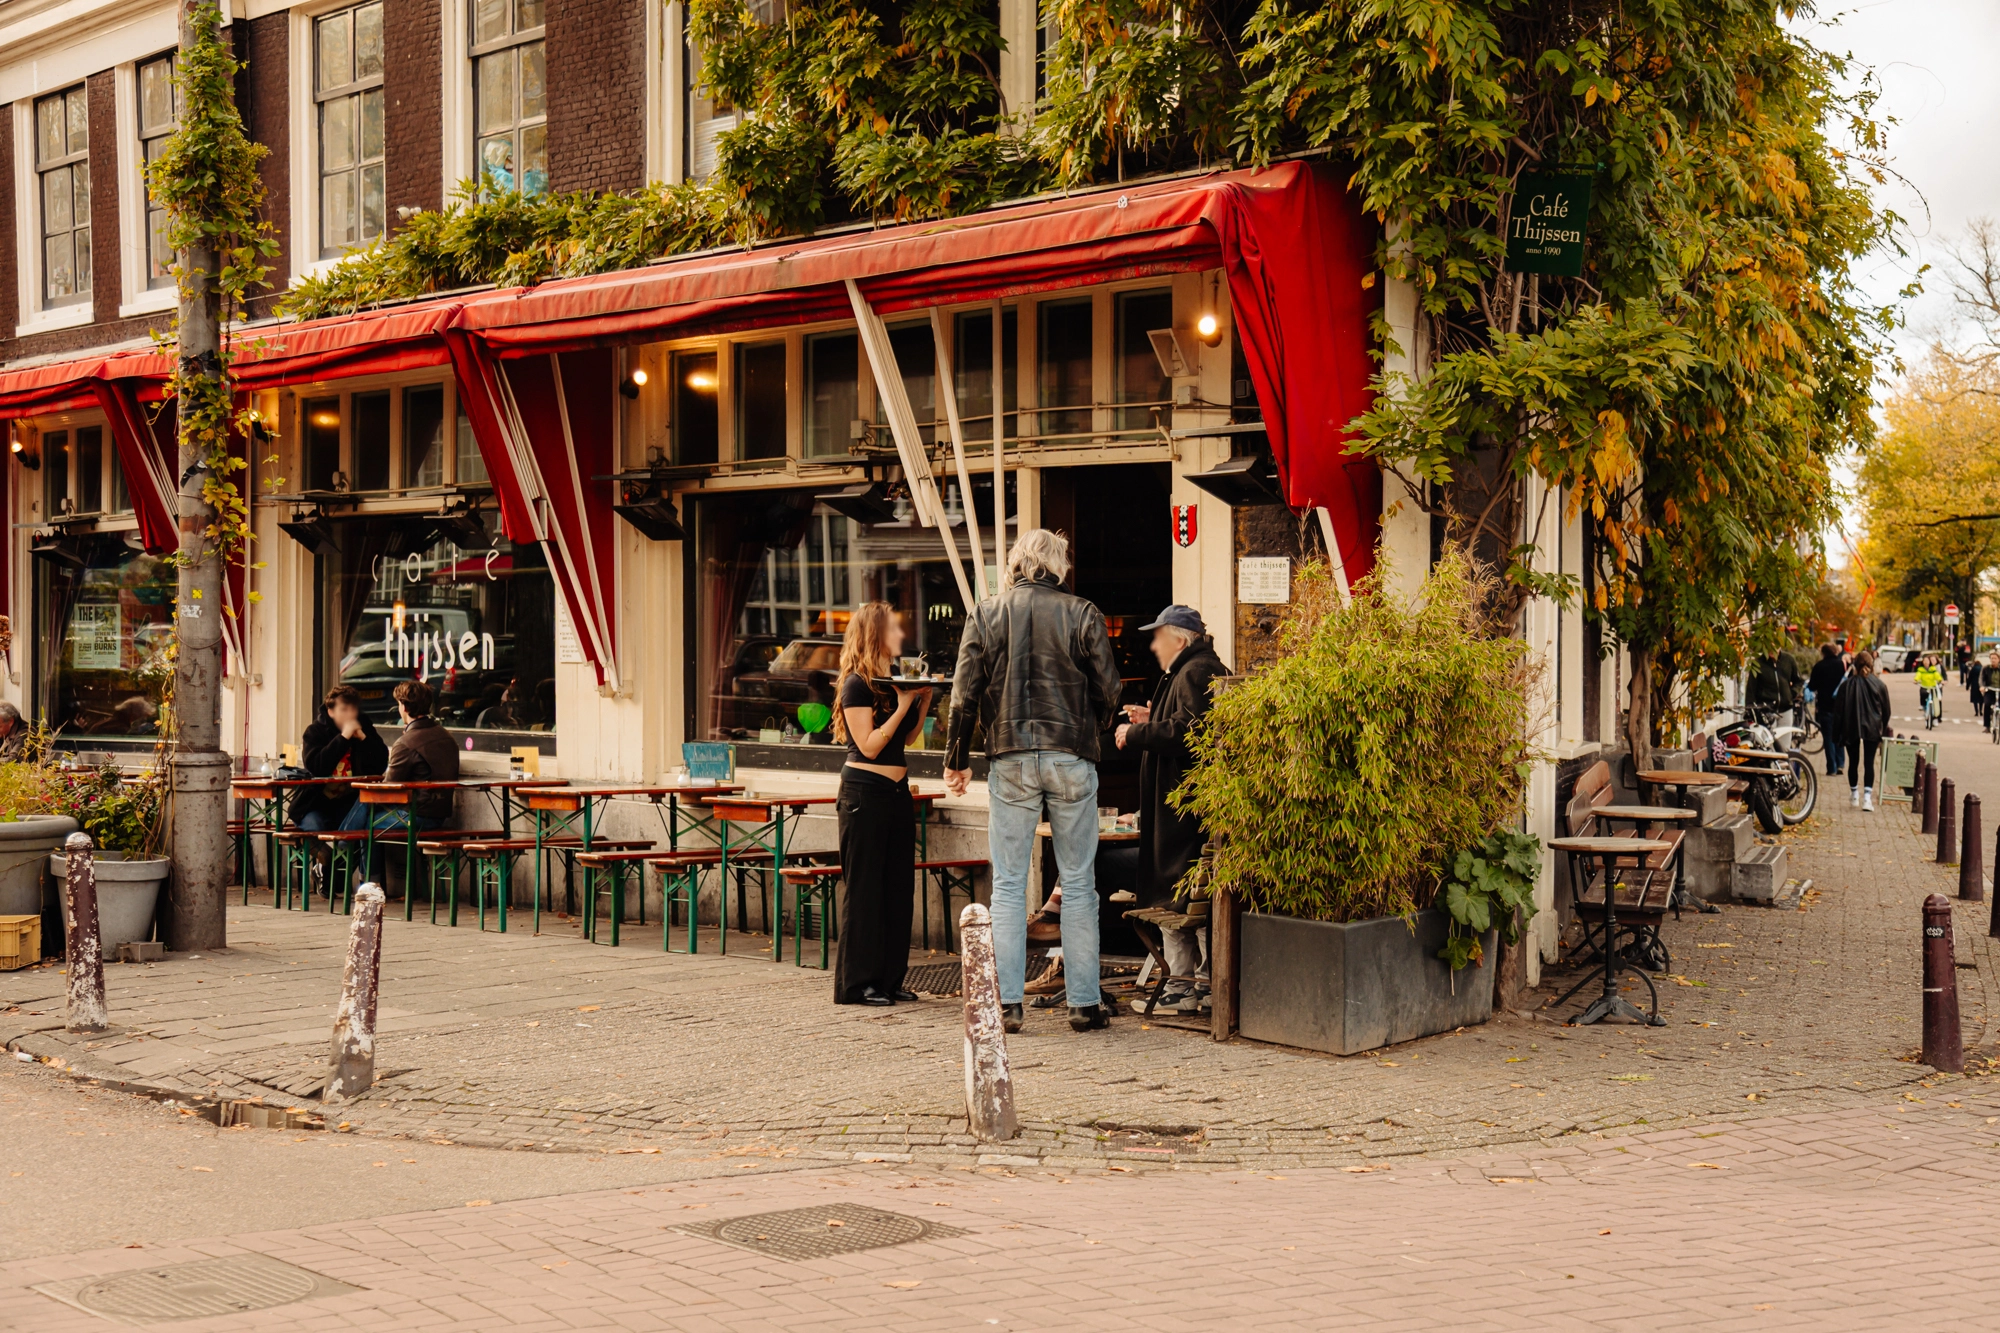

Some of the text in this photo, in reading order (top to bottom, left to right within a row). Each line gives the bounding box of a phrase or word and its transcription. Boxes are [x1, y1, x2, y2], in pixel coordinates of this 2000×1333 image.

[1530, 193, 1569, 218] Café
[1512, 214, 1580, 246] Thijssen
[1525, 246, 1561, 256] anno 1990
[1260, 560, 1287, 570] thijssen
[78, 606, 93, 621] THE
[94, 642, 117, 651] BURNS
[385, 605, 495, 684] thijssen
